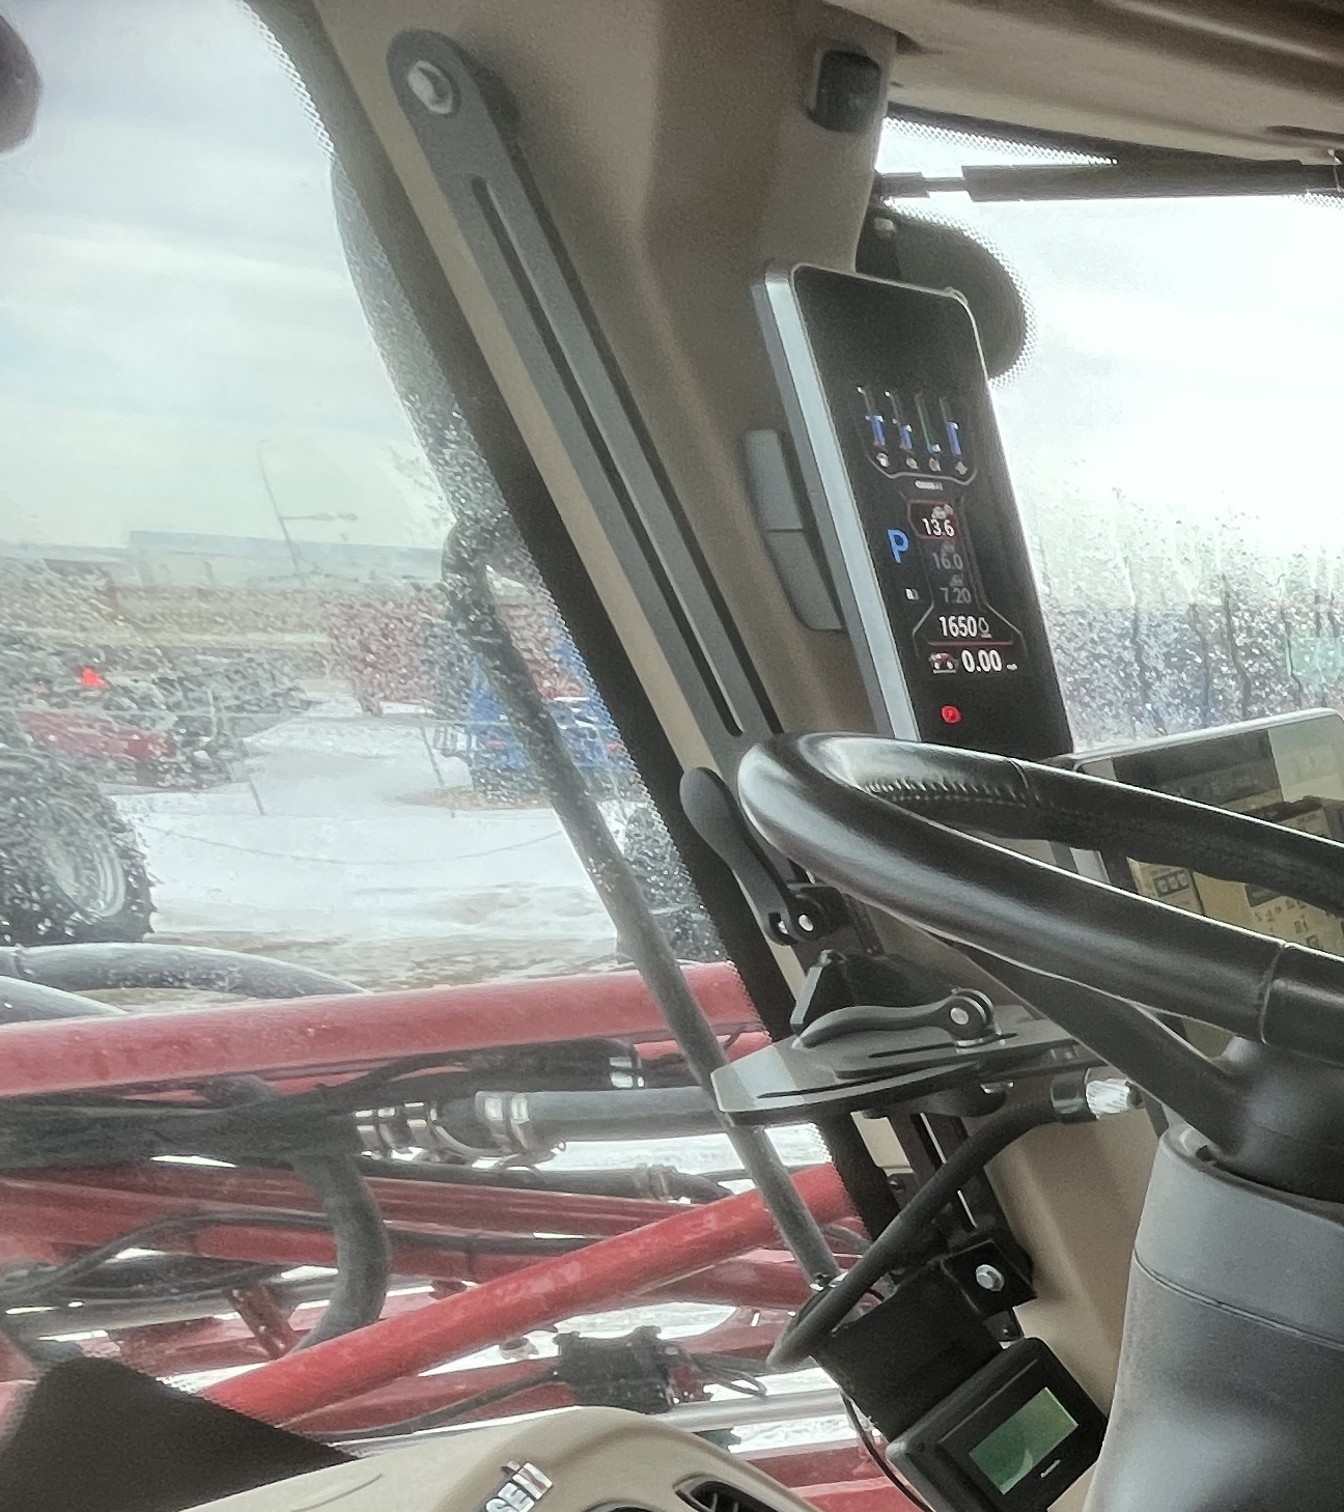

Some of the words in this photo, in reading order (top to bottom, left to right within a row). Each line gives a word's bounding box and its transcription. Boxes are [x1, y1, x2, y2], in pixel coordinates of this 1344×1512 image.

[922, 517, 955, 536] 13.6
[887, 528, 909, 563] P
[939, 616, 978, 637] 1650
[961, 650, 1002, 672] 0.00
